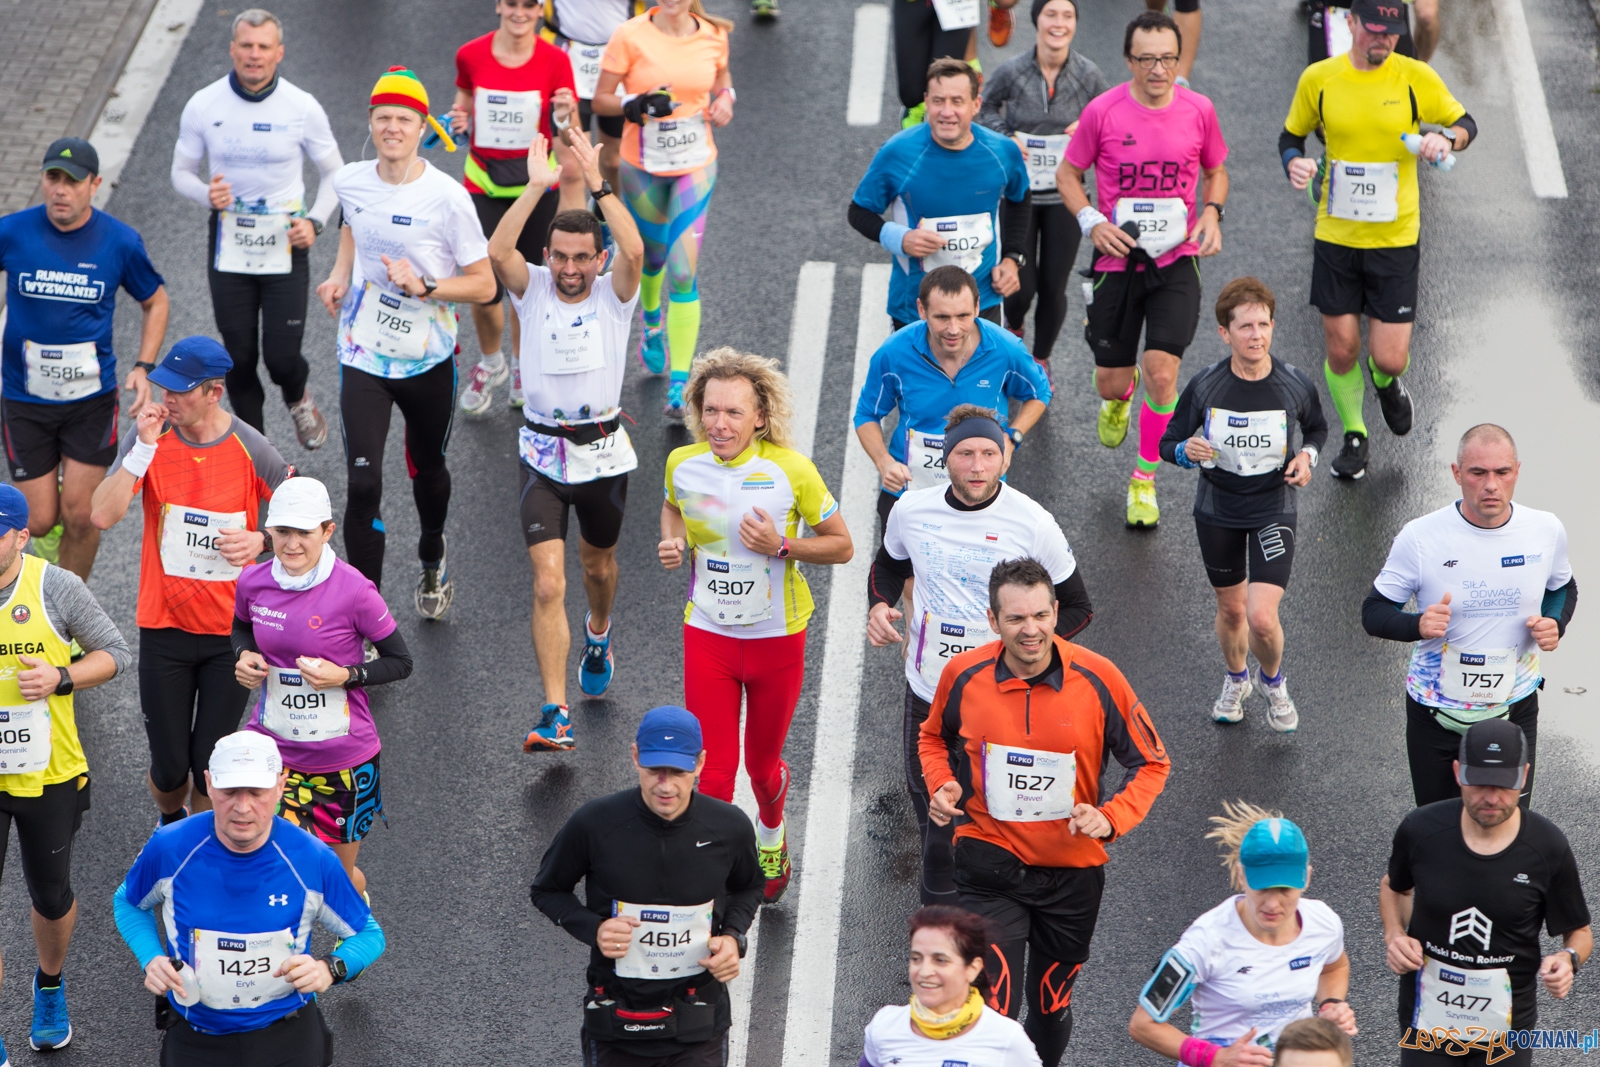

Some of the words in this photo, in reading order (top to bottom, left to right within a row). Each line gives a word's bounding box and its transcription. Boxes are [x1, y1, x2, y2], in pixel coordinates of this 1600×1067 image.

[1377, 6, 1400, 18] TYR
[488, 110, 523, 124] 3216
[657, 132, 697, 148] 5040
[1032, 154, 1057, 166] 313
[1351, 182, 1376, 196] 719
[235, 232, 276, 247] 5644
[36, 269, 89, 286] RUNNERS
[24, 279, 98, 299] WYZWANIE
[377, 309, 413, 334] 1785
[40, 365, 85, 380] 5586
[1224, 434, 1271, 449] 4605
[189, 550, 218, 561] Tomasz
[1442, 560, 1459, 568] 4F
[707, 579, 755, 596] 4307
[1462, 580, 1487, 590] SIŁA
[1470, 588, 1522, 599] ODWAGA
[717, 598, 743, 606] Marek
[1462, 597, 1521, 609] SZYBKOŚĆ
[0, 641, 45, 656] BIEGA
[1461, 672, 1505, 689] 1757
[281, 693, 326, 710] 4091
[1470, 691, 1494, 699] Jakub
[289, 712, 318, 720] Danuta
[1007, 772, 1056, 791] 1627
[639, 929, 691, 948] 4614
[1425, 940, 1449, 957] Polski
[1451, 951, 1475, 963] Dom
[1476, 954, 1516, 964] Rolniczy
[218, 956, 271, 977] 1423
[235, 980, 256, 988] Eryk
[1436, 990, 1493, 1012] 4477
[1445, 1010, 1480, 1022] Szymon
